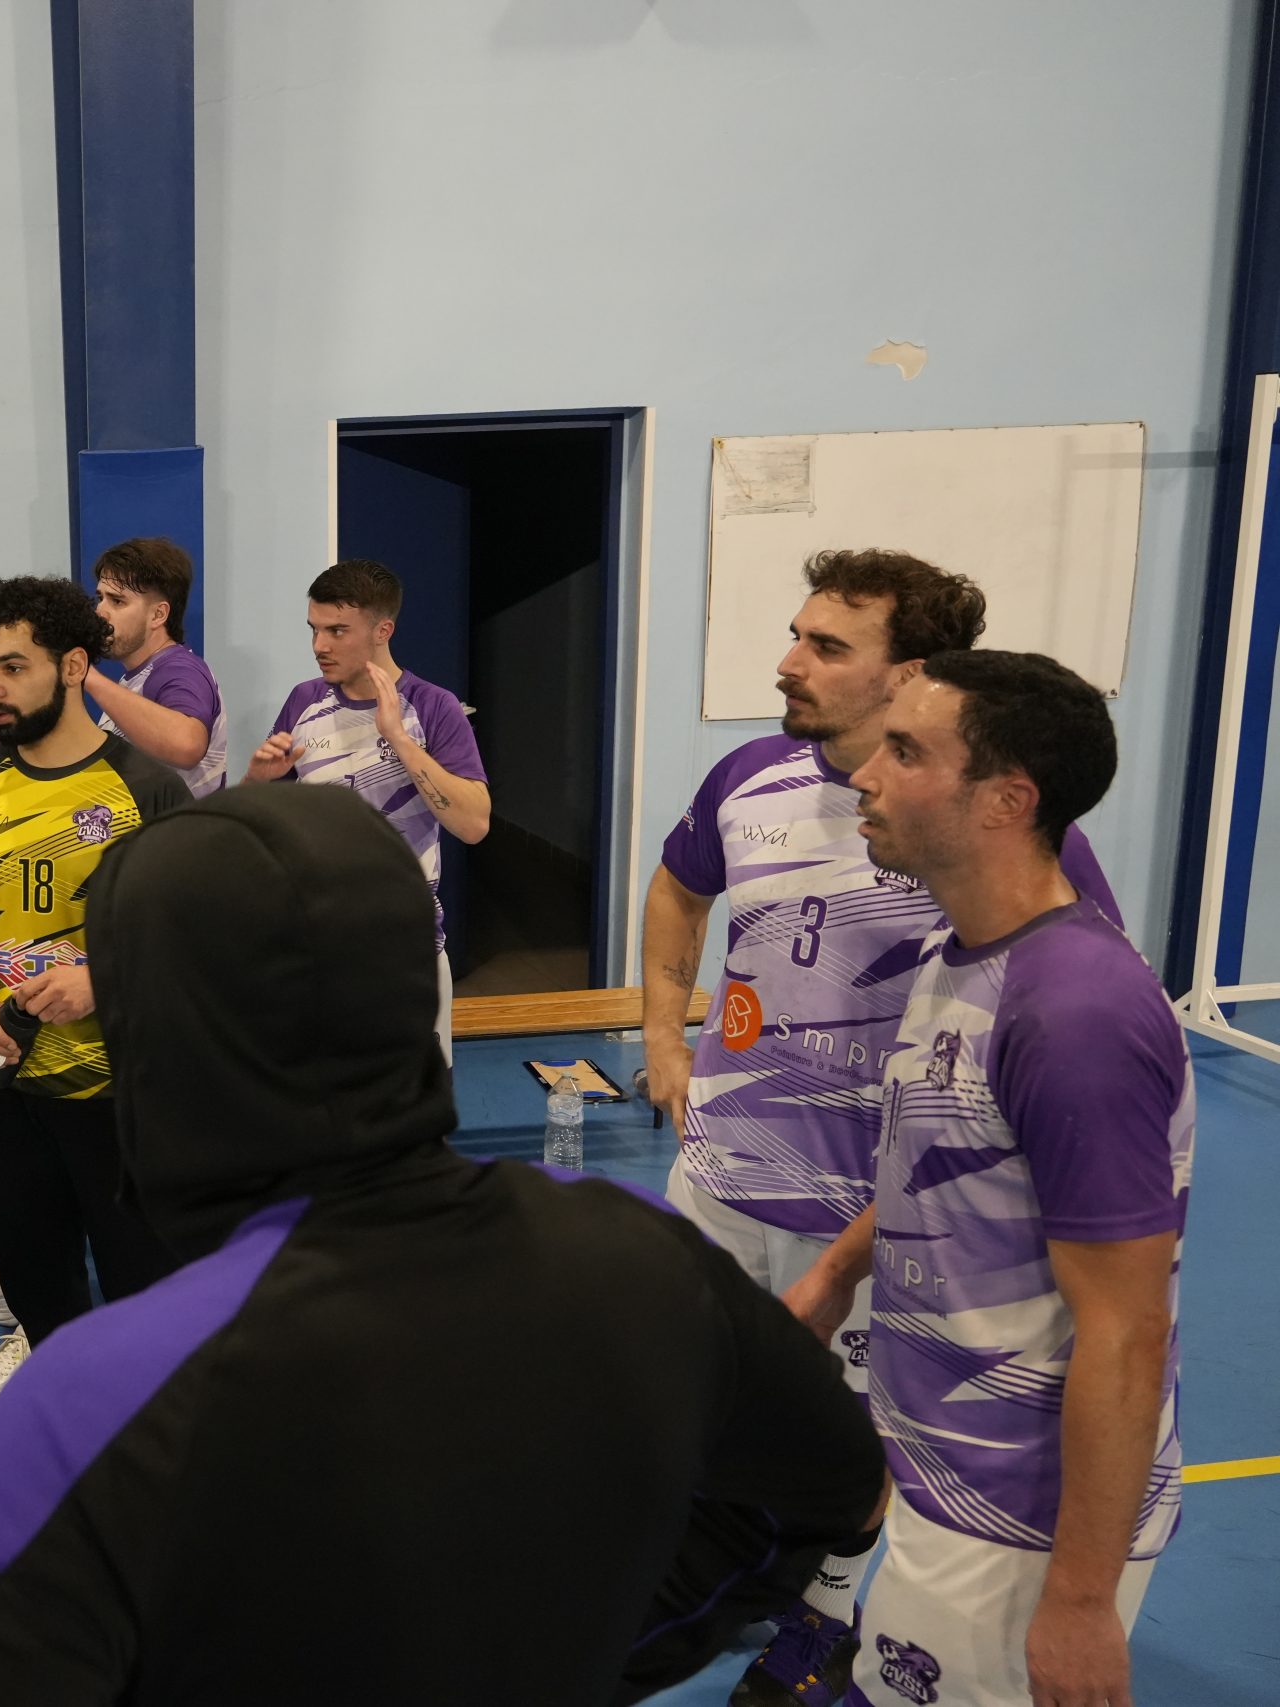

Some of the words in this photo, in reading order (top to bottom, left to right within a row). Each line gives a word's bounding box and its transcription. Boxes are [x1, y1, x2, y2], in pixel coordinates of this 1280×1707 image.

[16, 856, 56, 915] 18
[790, 894, 830, 970] 3
[814, 1575, 851, 1590] rima
